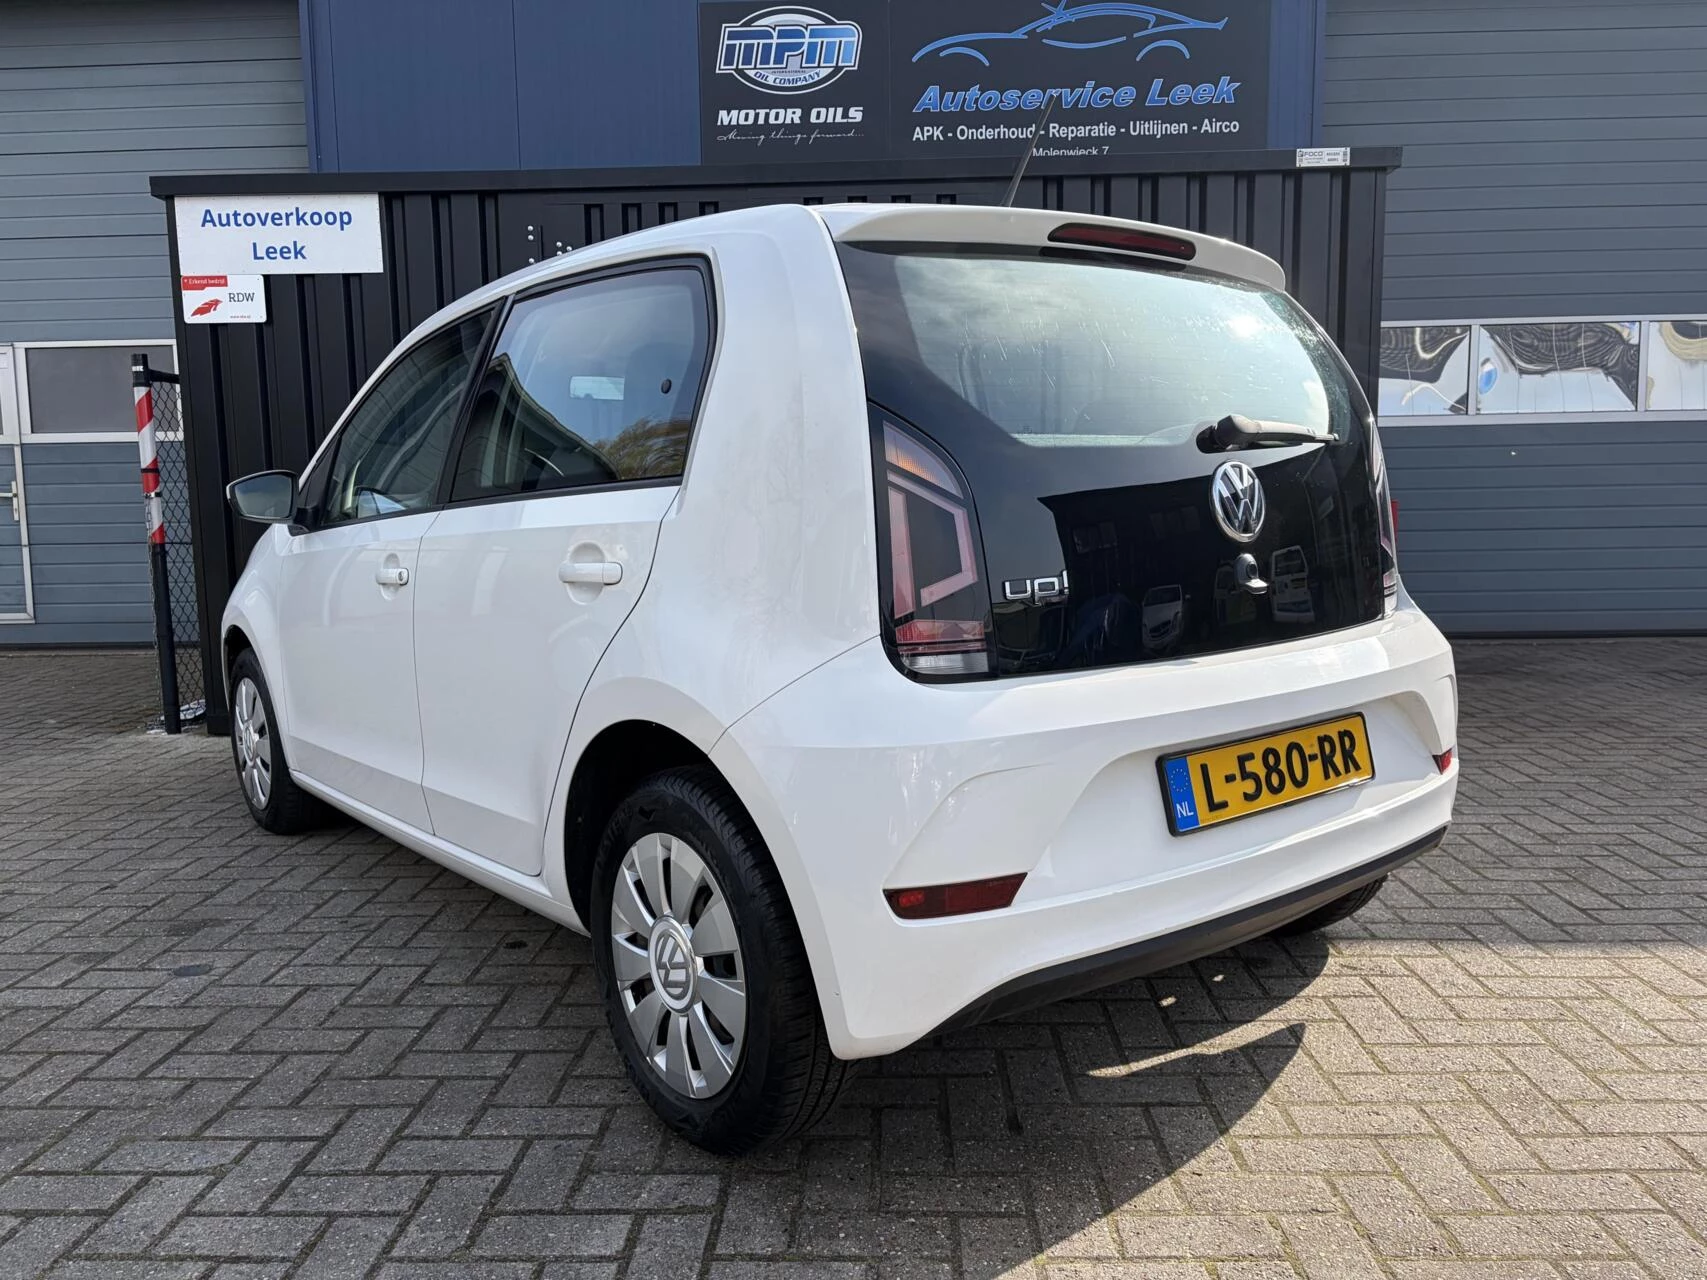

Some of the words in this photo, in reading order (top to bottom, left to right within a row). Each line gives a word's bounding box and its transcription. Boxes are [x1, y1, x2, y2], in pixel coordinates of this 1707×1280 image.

[753, 71, 770, 83] OIL
[772, 69, 822, 86] COMPANY
[913, 80, 1136, 113] Autoservice
[1145, 76, 1242, 107] Leek
[717, 108, 802, 126] MOTOR
[809, 106, 864, 124] OILS
[716, 129, 765, 146] Moving
[769, 128, 808, 145] things
[912, 125, 944, 141] APK
[956, 124, 1036, 141] Onderhoud
[1049, 121, 1116, 141] Reparatie
[1129, 119, 1188, 139] Uitlijnen
[1200, 118, 1240, 134] Airco
[1102, 146, 1110, 155] 7
[201, 207, 352, 231] Autoverkoop
[252, 241, 307, 260] Leek
[228, 292, 255, 303] RDW
[1004, 569, 1069, 605] up!
[1200, 729, 1361, 812] L-580-RR
[1176, 801, 1194, 818] NL
